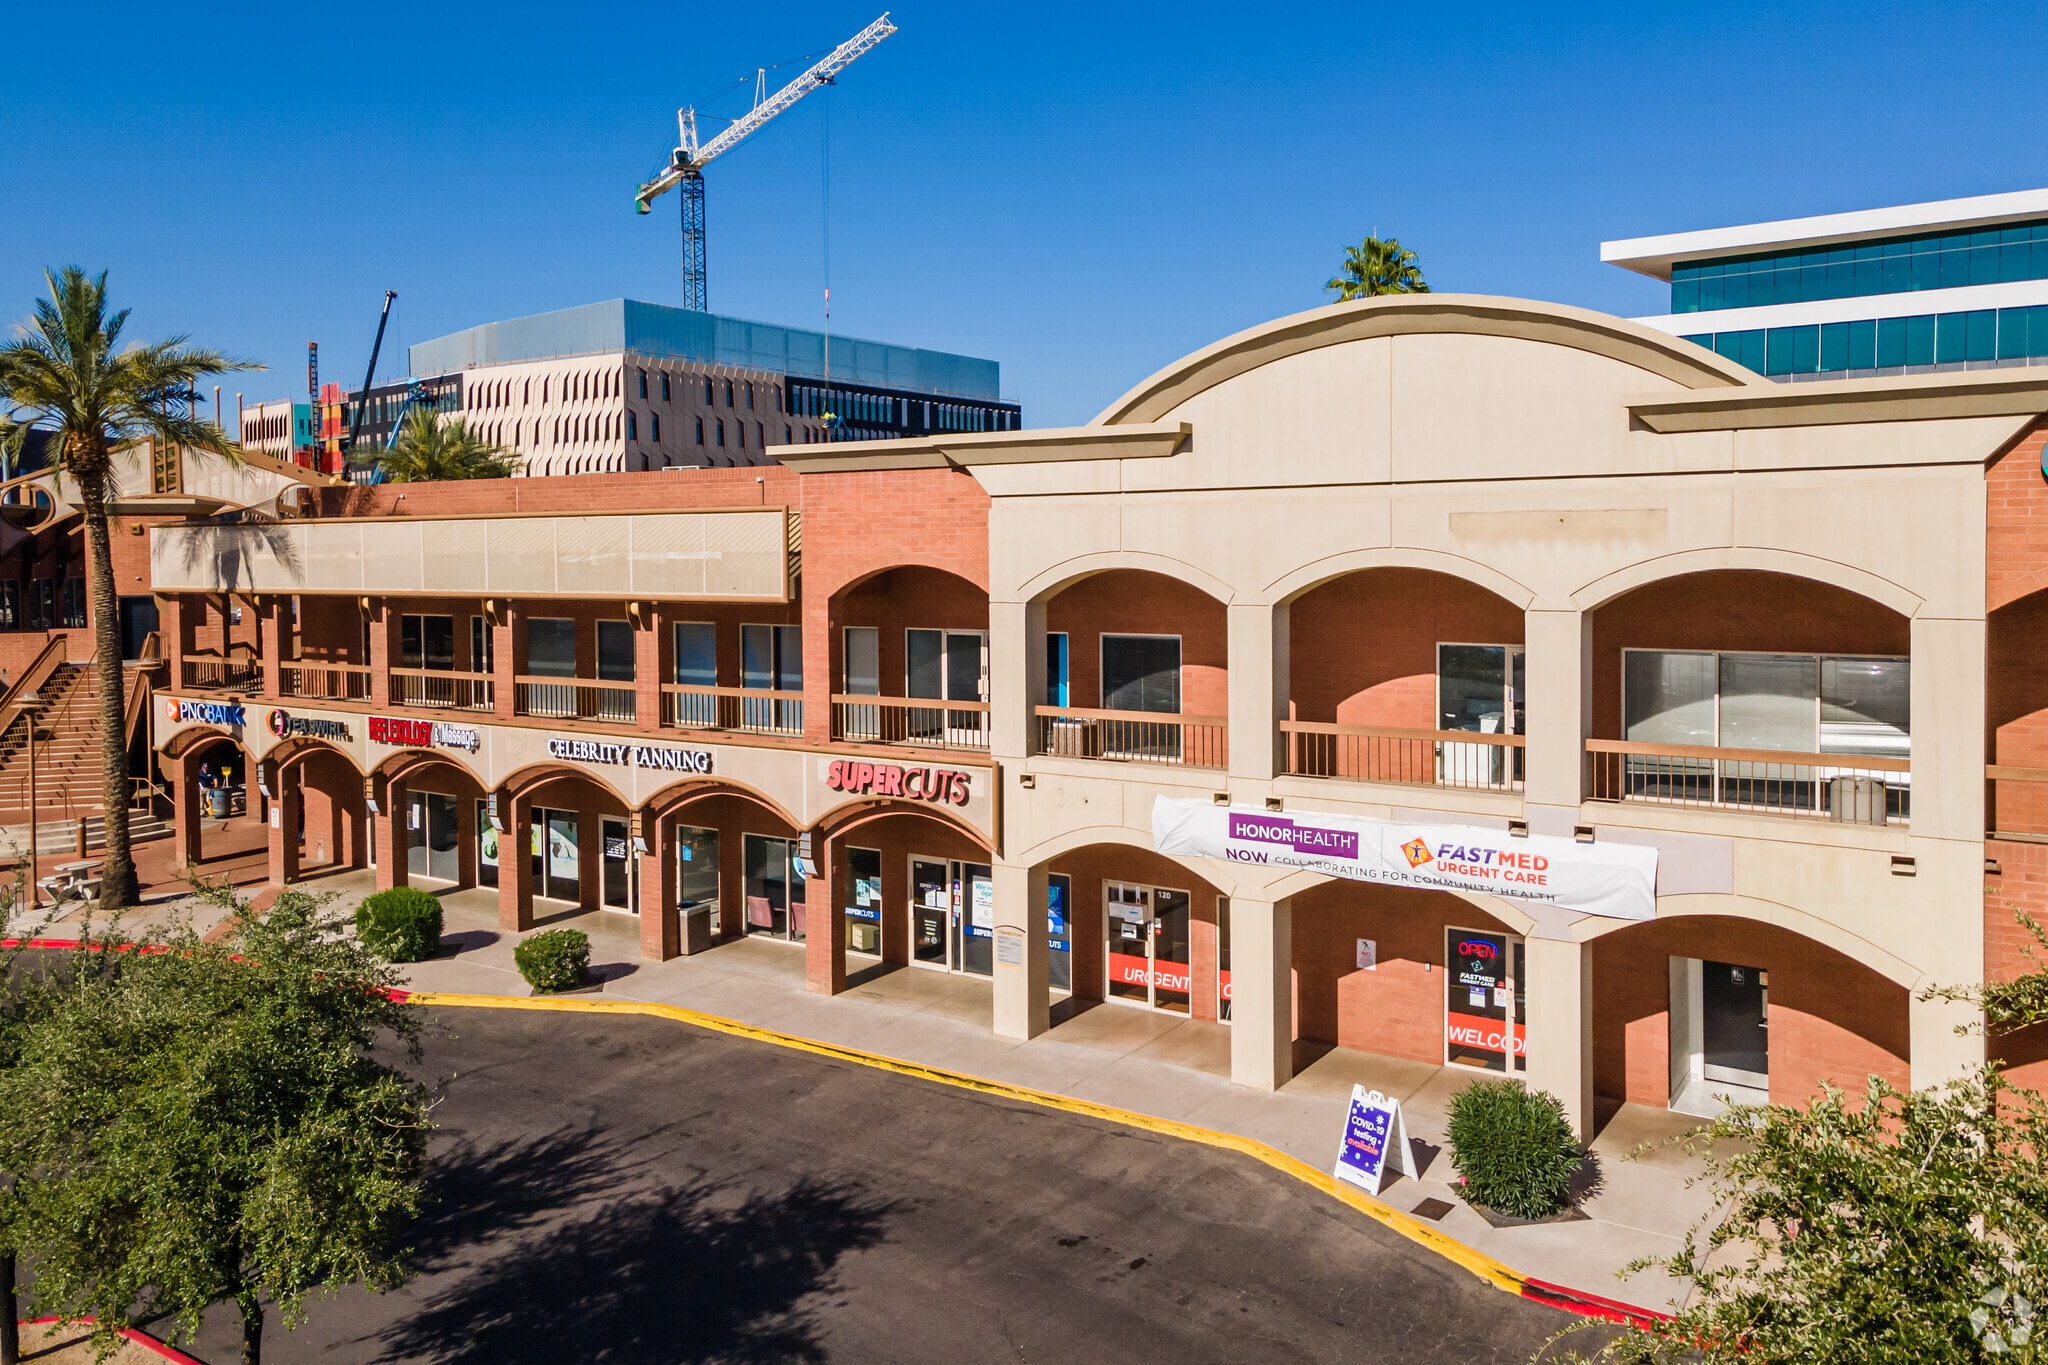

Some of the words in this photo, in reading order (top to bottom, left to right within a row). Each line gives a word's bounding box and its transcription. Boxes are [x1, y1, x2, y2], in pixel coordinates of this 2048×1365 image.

[369, 717, 433, 747] REFLEXOLOGY
[441, 723, 475, 750] Massage
[547, 739, 626, 763] CELEBRITY
[630, 746, 709, 771] TANNING
[826, 760, 967, 803] SUPERCUTS
[1437, 843, 1549, 871] FASTMED
[1225, 847, 1268, 864] NOW
[1274, 856, 1377, 878] COLLABORATING
[1382, 871, 1408, 881] FOR
[1414, 875, 1495, 893] COMMUNITY
[1500, 888, 1555, 902] HEALTH
[1437, 861, 1499, 879] URGENT
[1503, 870, 1547, 886] CARE
[1158, 891, 1171, 899] 120
[1458, 941, 1496, 960] OPEN
[1460, 972, 1495, 983] FASTMED
[1351, 1115, 1385, 1135] COVID-19
[1347, 1137, 1379, 1156] available
[1353, 1128, 1377, 1146] testing
